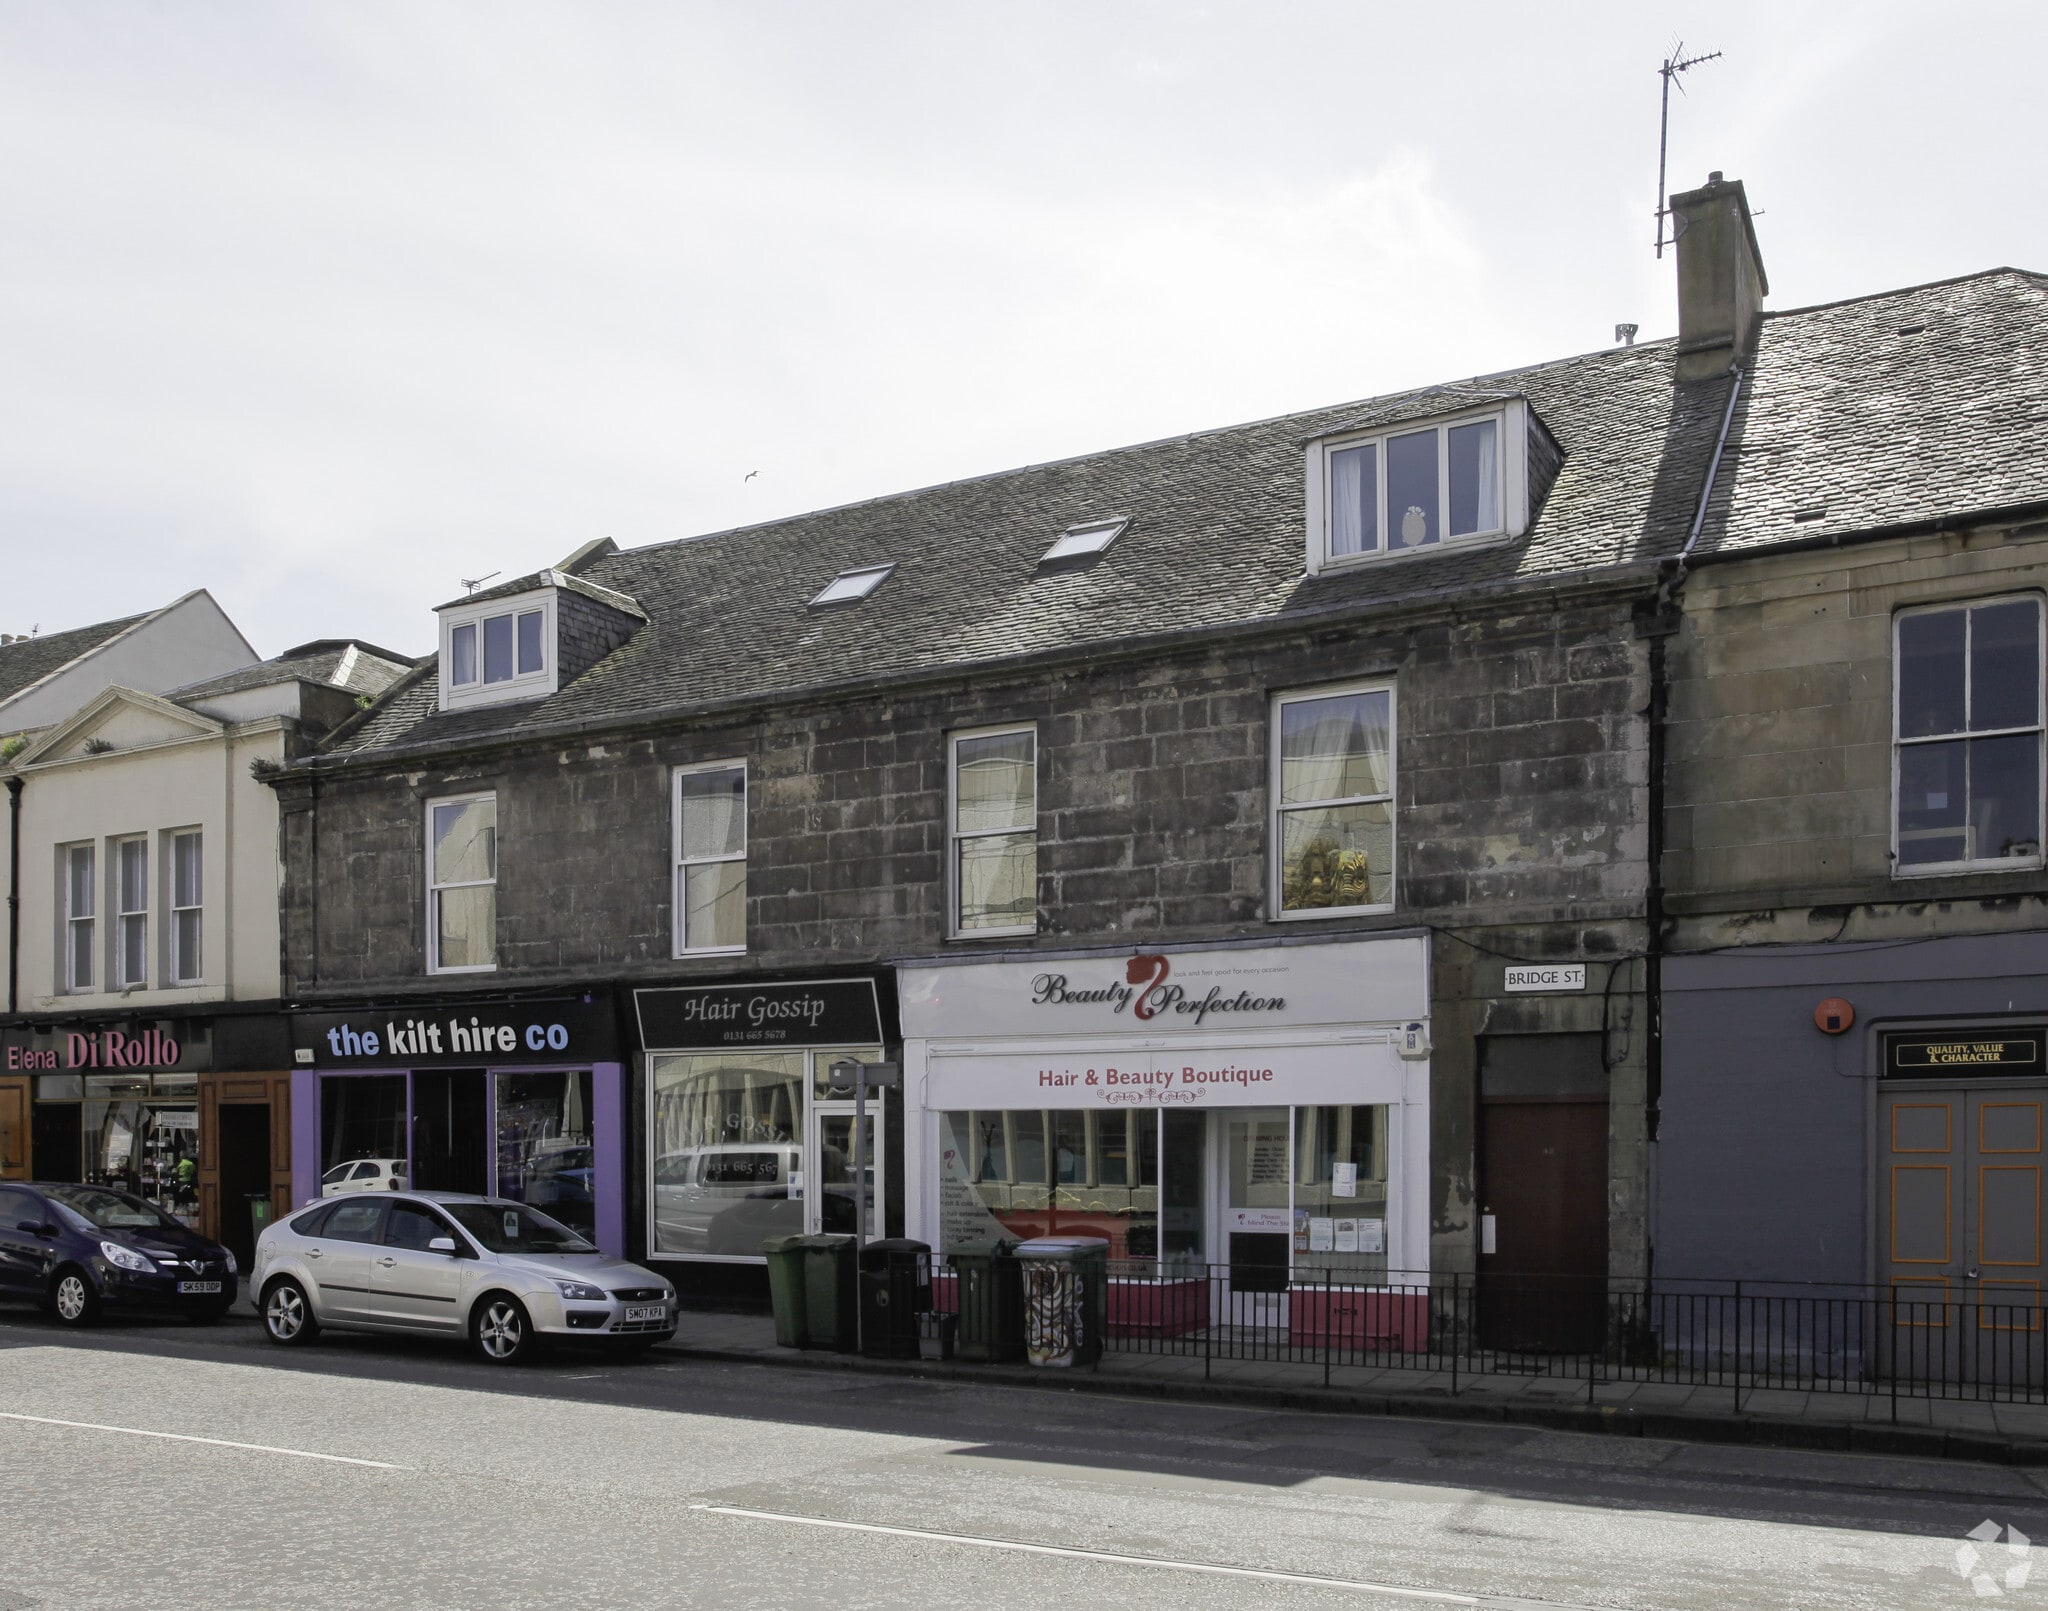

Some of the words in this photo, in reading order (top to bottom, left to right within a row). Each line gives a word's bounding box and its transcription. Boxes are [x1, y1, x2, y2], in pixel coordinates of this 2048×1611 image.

[1174, 970, 1187, 978] look
[1188, 969, 1200, 977] and
[1201, 968, 1213, 977] feel
[1214, 968, 1231, 977] good
[1232, 966, 1243, 975] for
[1243, 967, 1260, 976] every
[1261, 965, 1290, 974] occasion
[1507, 969, 1560, 986] BRIDGE
[1564, 968, 1583, 984] ST.
[1031, 972, 1134, 1014] Beauty
[1147, 985, 1286, 1024] Perfection
[684, 995, 742, 1022] Hair
[747, 994, 826, 1027] Gossip
[327, 1024, 380, 1057] the
[387, 1019, 444, 1055] kilt
[450, 1017, 518, 1053] hire
[525, 1023, 570, 1051] co
[723, 1031, 745, 1041] 0131
[745, 1030, 763, 1040] 665
[764, 1029, 787, 1040] 5678
[7, 1046, 58, 1070] Elena
[66, 1032, 99, 1069] Di
[104, 1030, 179, 1068] Rollo
[1926, 1044, 1970, 1054] QUALITY,
[1973, 1043, 2004, 1053] VALUE
[1930, 1053, 1939, 1063] &
[1941, 1052, 2001, 1063] CHARACTER
[1038, 1069, 1079, 1088] Hair
[1084, 1070, 1099, 1086] &
[1105, 1067, 1174, 1090] Beauty
[1181, 1065, 1274, 1088] Boutique
[733, 1160, 754, 1175] 665
[183, 1282, 205, 1292] SK59
